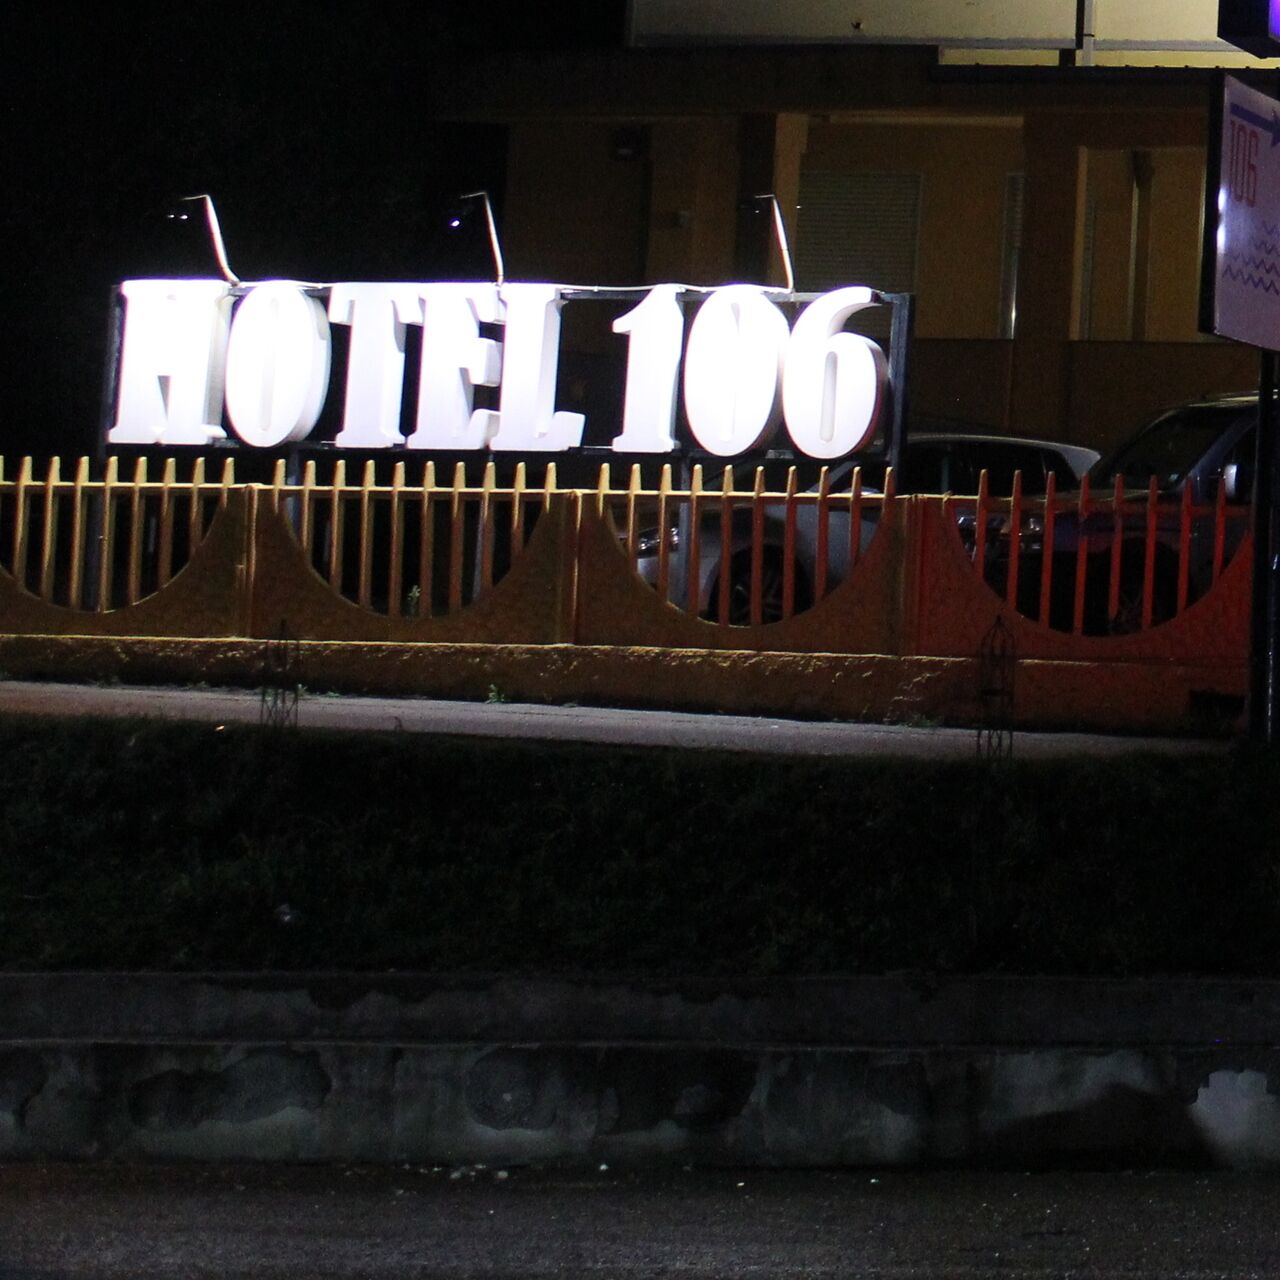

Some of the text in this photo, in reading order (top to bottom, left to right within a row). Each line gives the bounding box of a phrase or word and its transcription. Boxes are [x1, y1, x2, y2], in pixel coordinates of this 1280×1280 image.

[1229, 119, 1259, 208] 106
[106, 279, 888, 460] HOTEL 106
